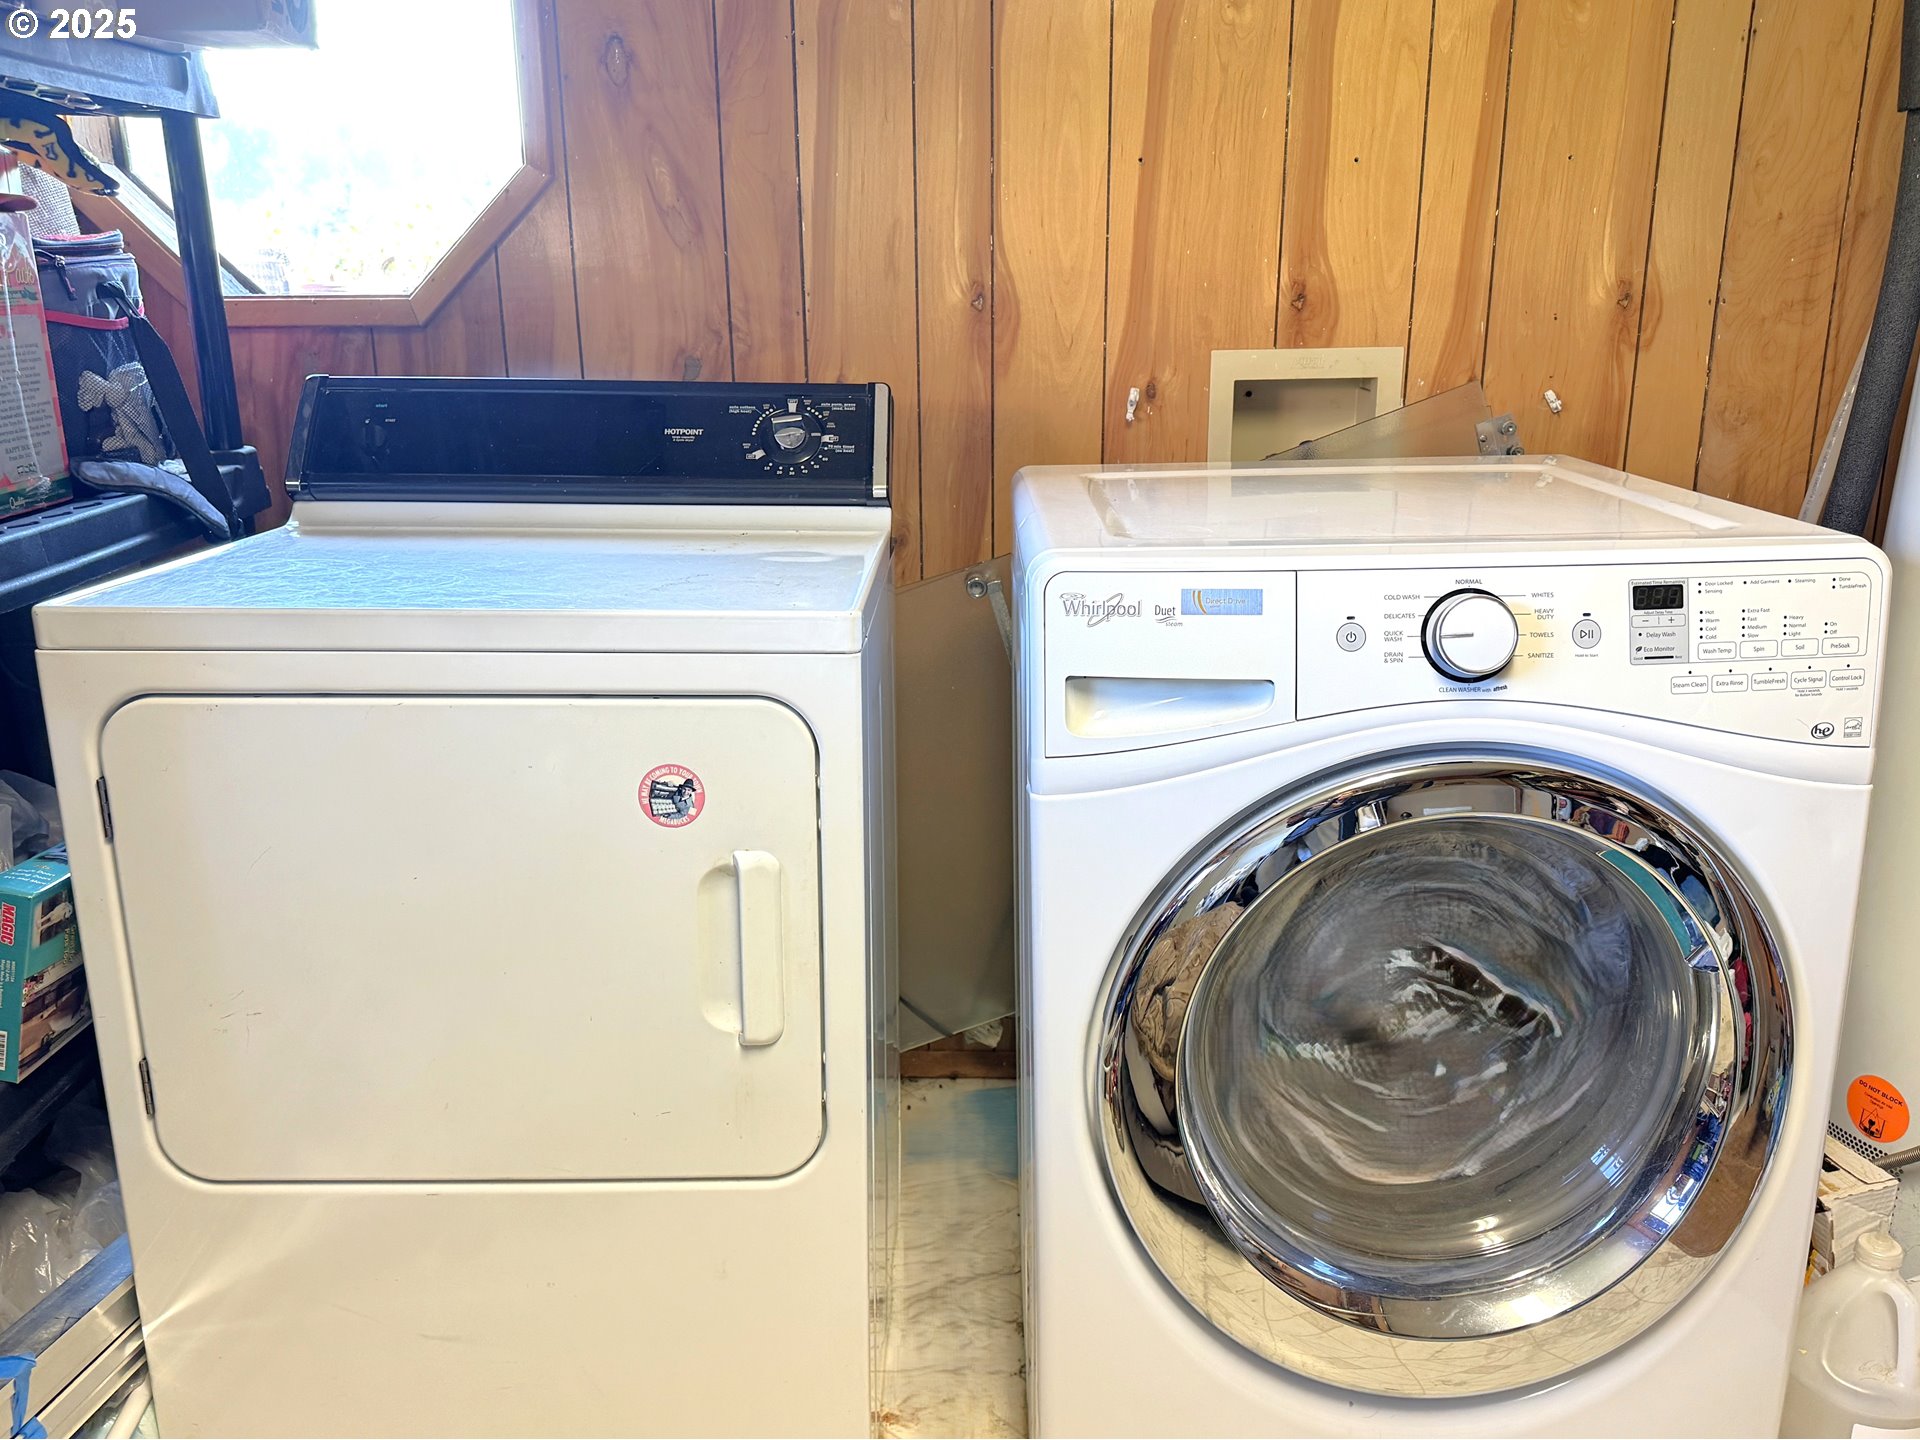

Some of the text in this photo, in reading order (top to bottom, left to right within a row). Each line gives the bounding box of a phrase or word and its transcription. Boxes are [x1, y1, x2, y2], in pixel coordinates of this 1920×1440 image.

[1062, 597, 1142, 623] Whirlpool
[1154, 604, 1177, 616] Duet
[1813, 724, 1832, 738] he
[650, 767, 670, 780] COMING
[1, 902, 16, 946] MAGIC
[1868, 1085, 1881, 1094] NOT
[1881, 1092, 1903, 1106] BLOCK
